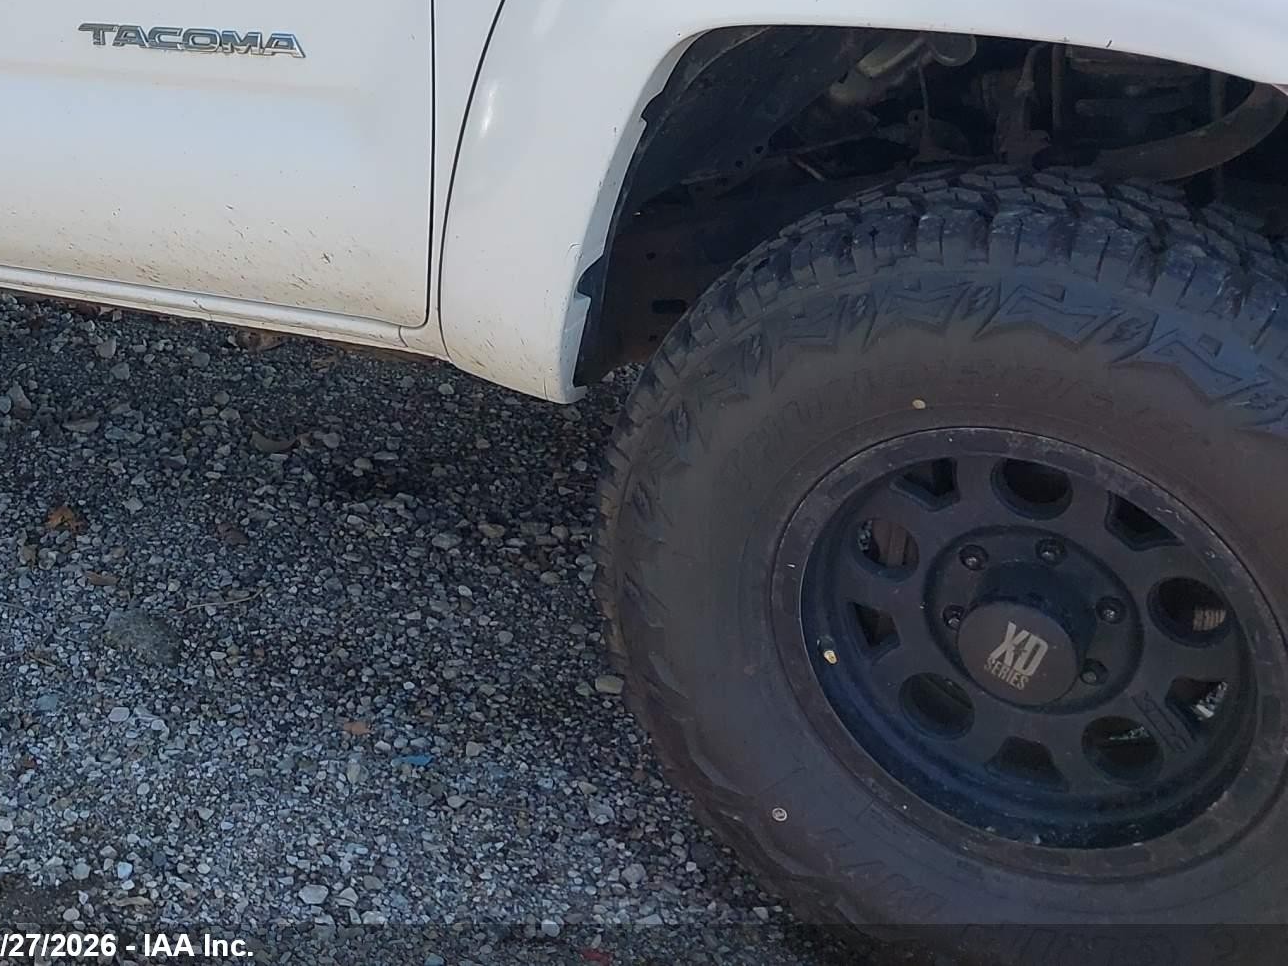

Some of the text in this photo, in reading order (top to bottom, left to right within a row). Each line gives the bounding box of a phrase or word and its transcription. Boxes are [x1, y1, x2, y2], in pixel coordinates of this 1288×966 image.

[78, 22, 306, 58] TACOMA
[989, 621, 1049, 676] XD
[983, 656, 1029, 691] SERIES
